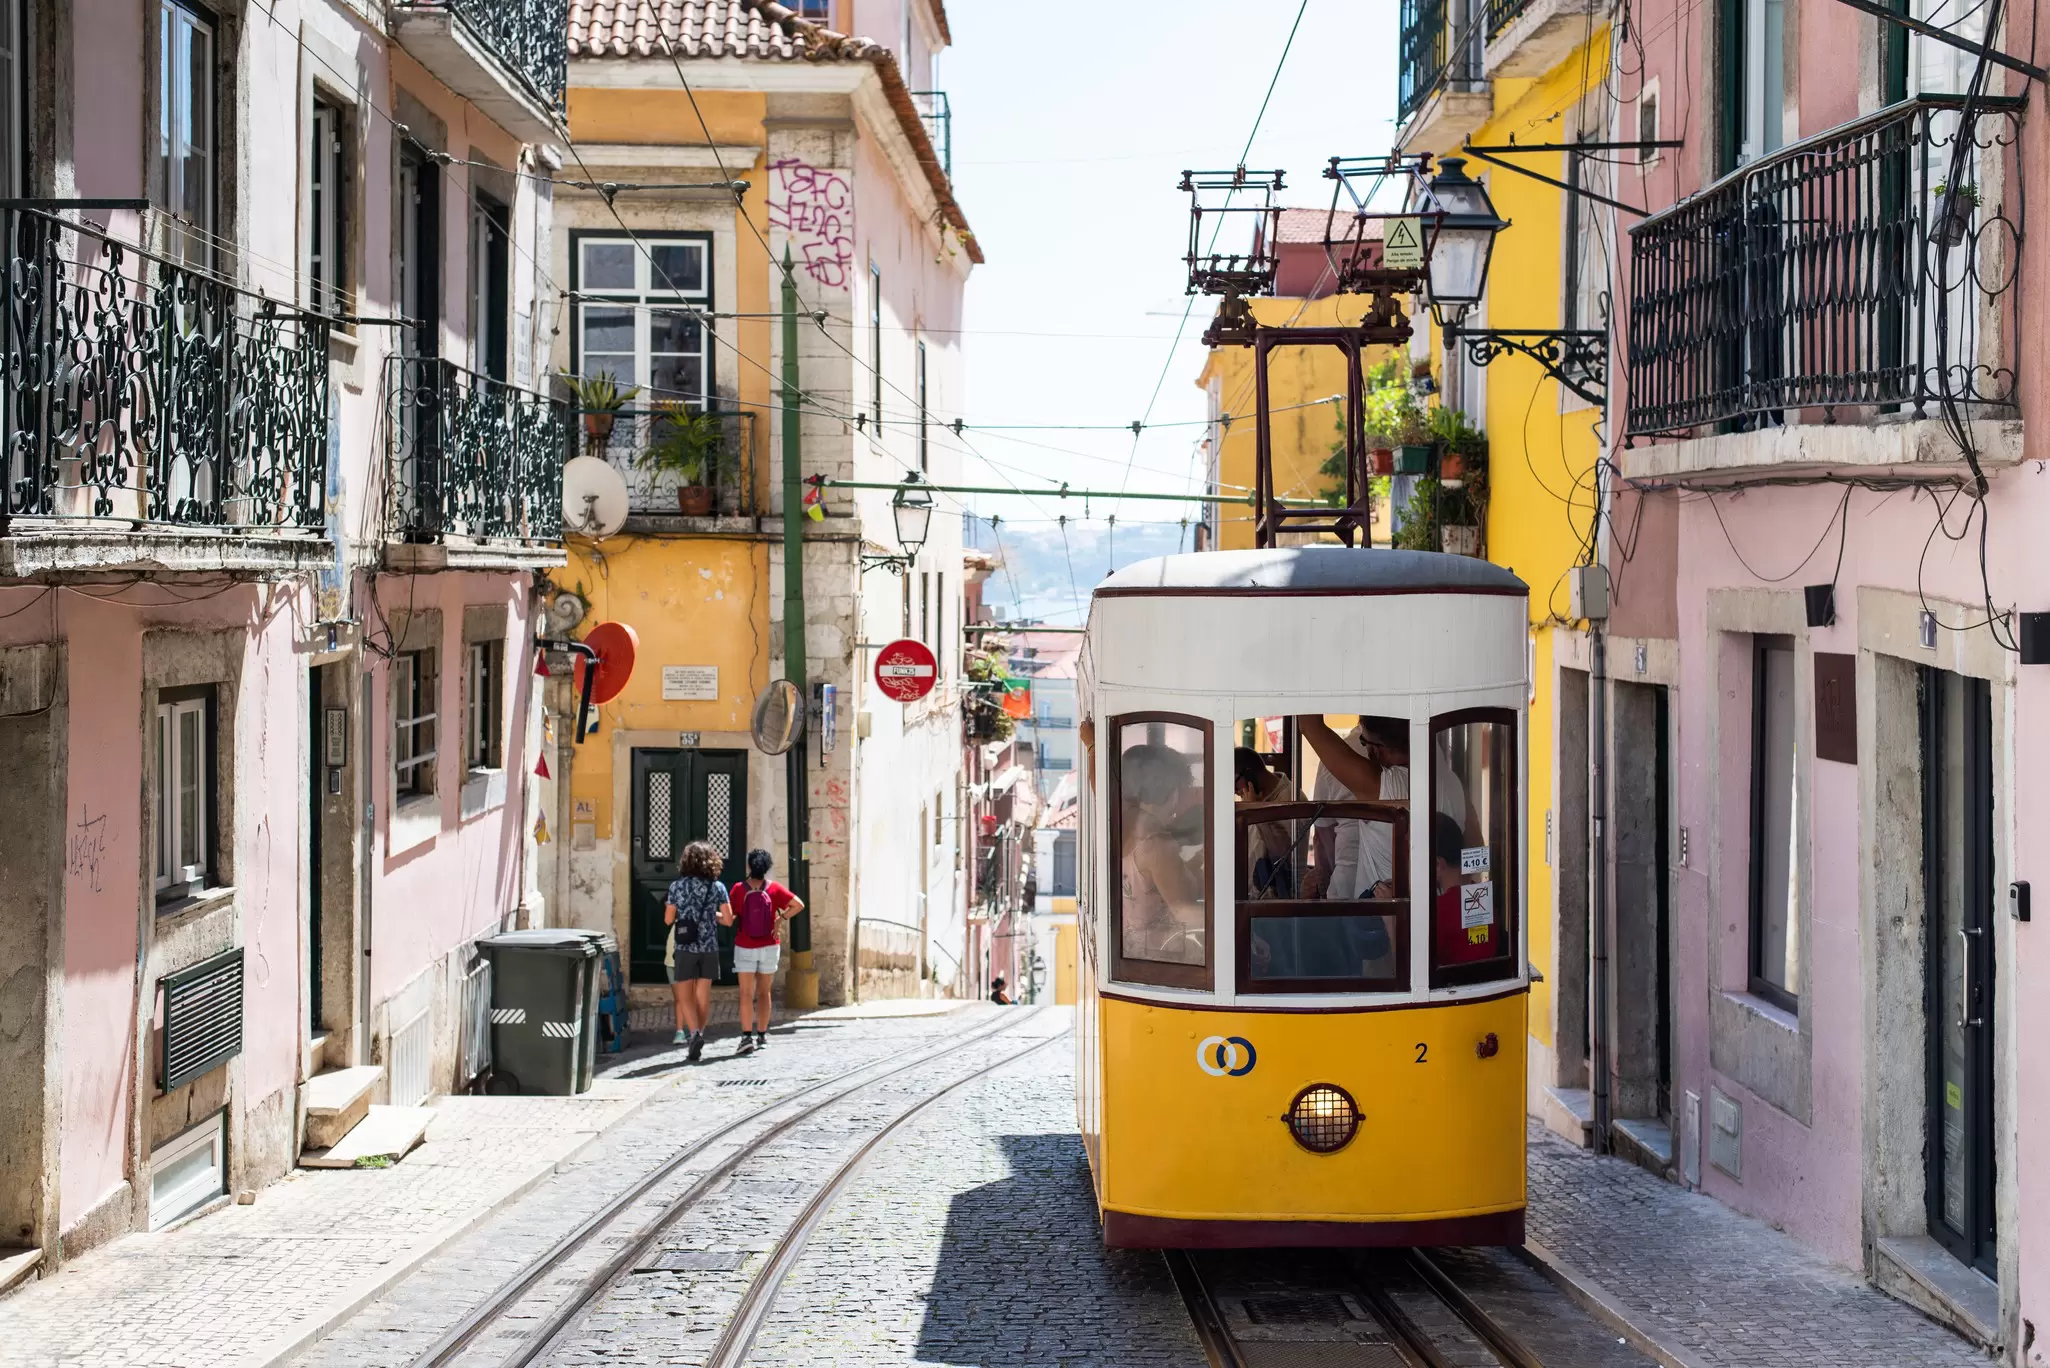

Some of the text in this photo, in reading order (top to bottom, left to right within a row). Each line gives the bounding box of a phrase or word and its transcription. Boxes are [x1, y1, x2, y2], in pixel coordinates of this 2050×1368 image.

[576, 801, 592, 812] AL
[1463, 857, 1488, 868] 4.10 €
[1415, 1042, 1428, 1063] 2
